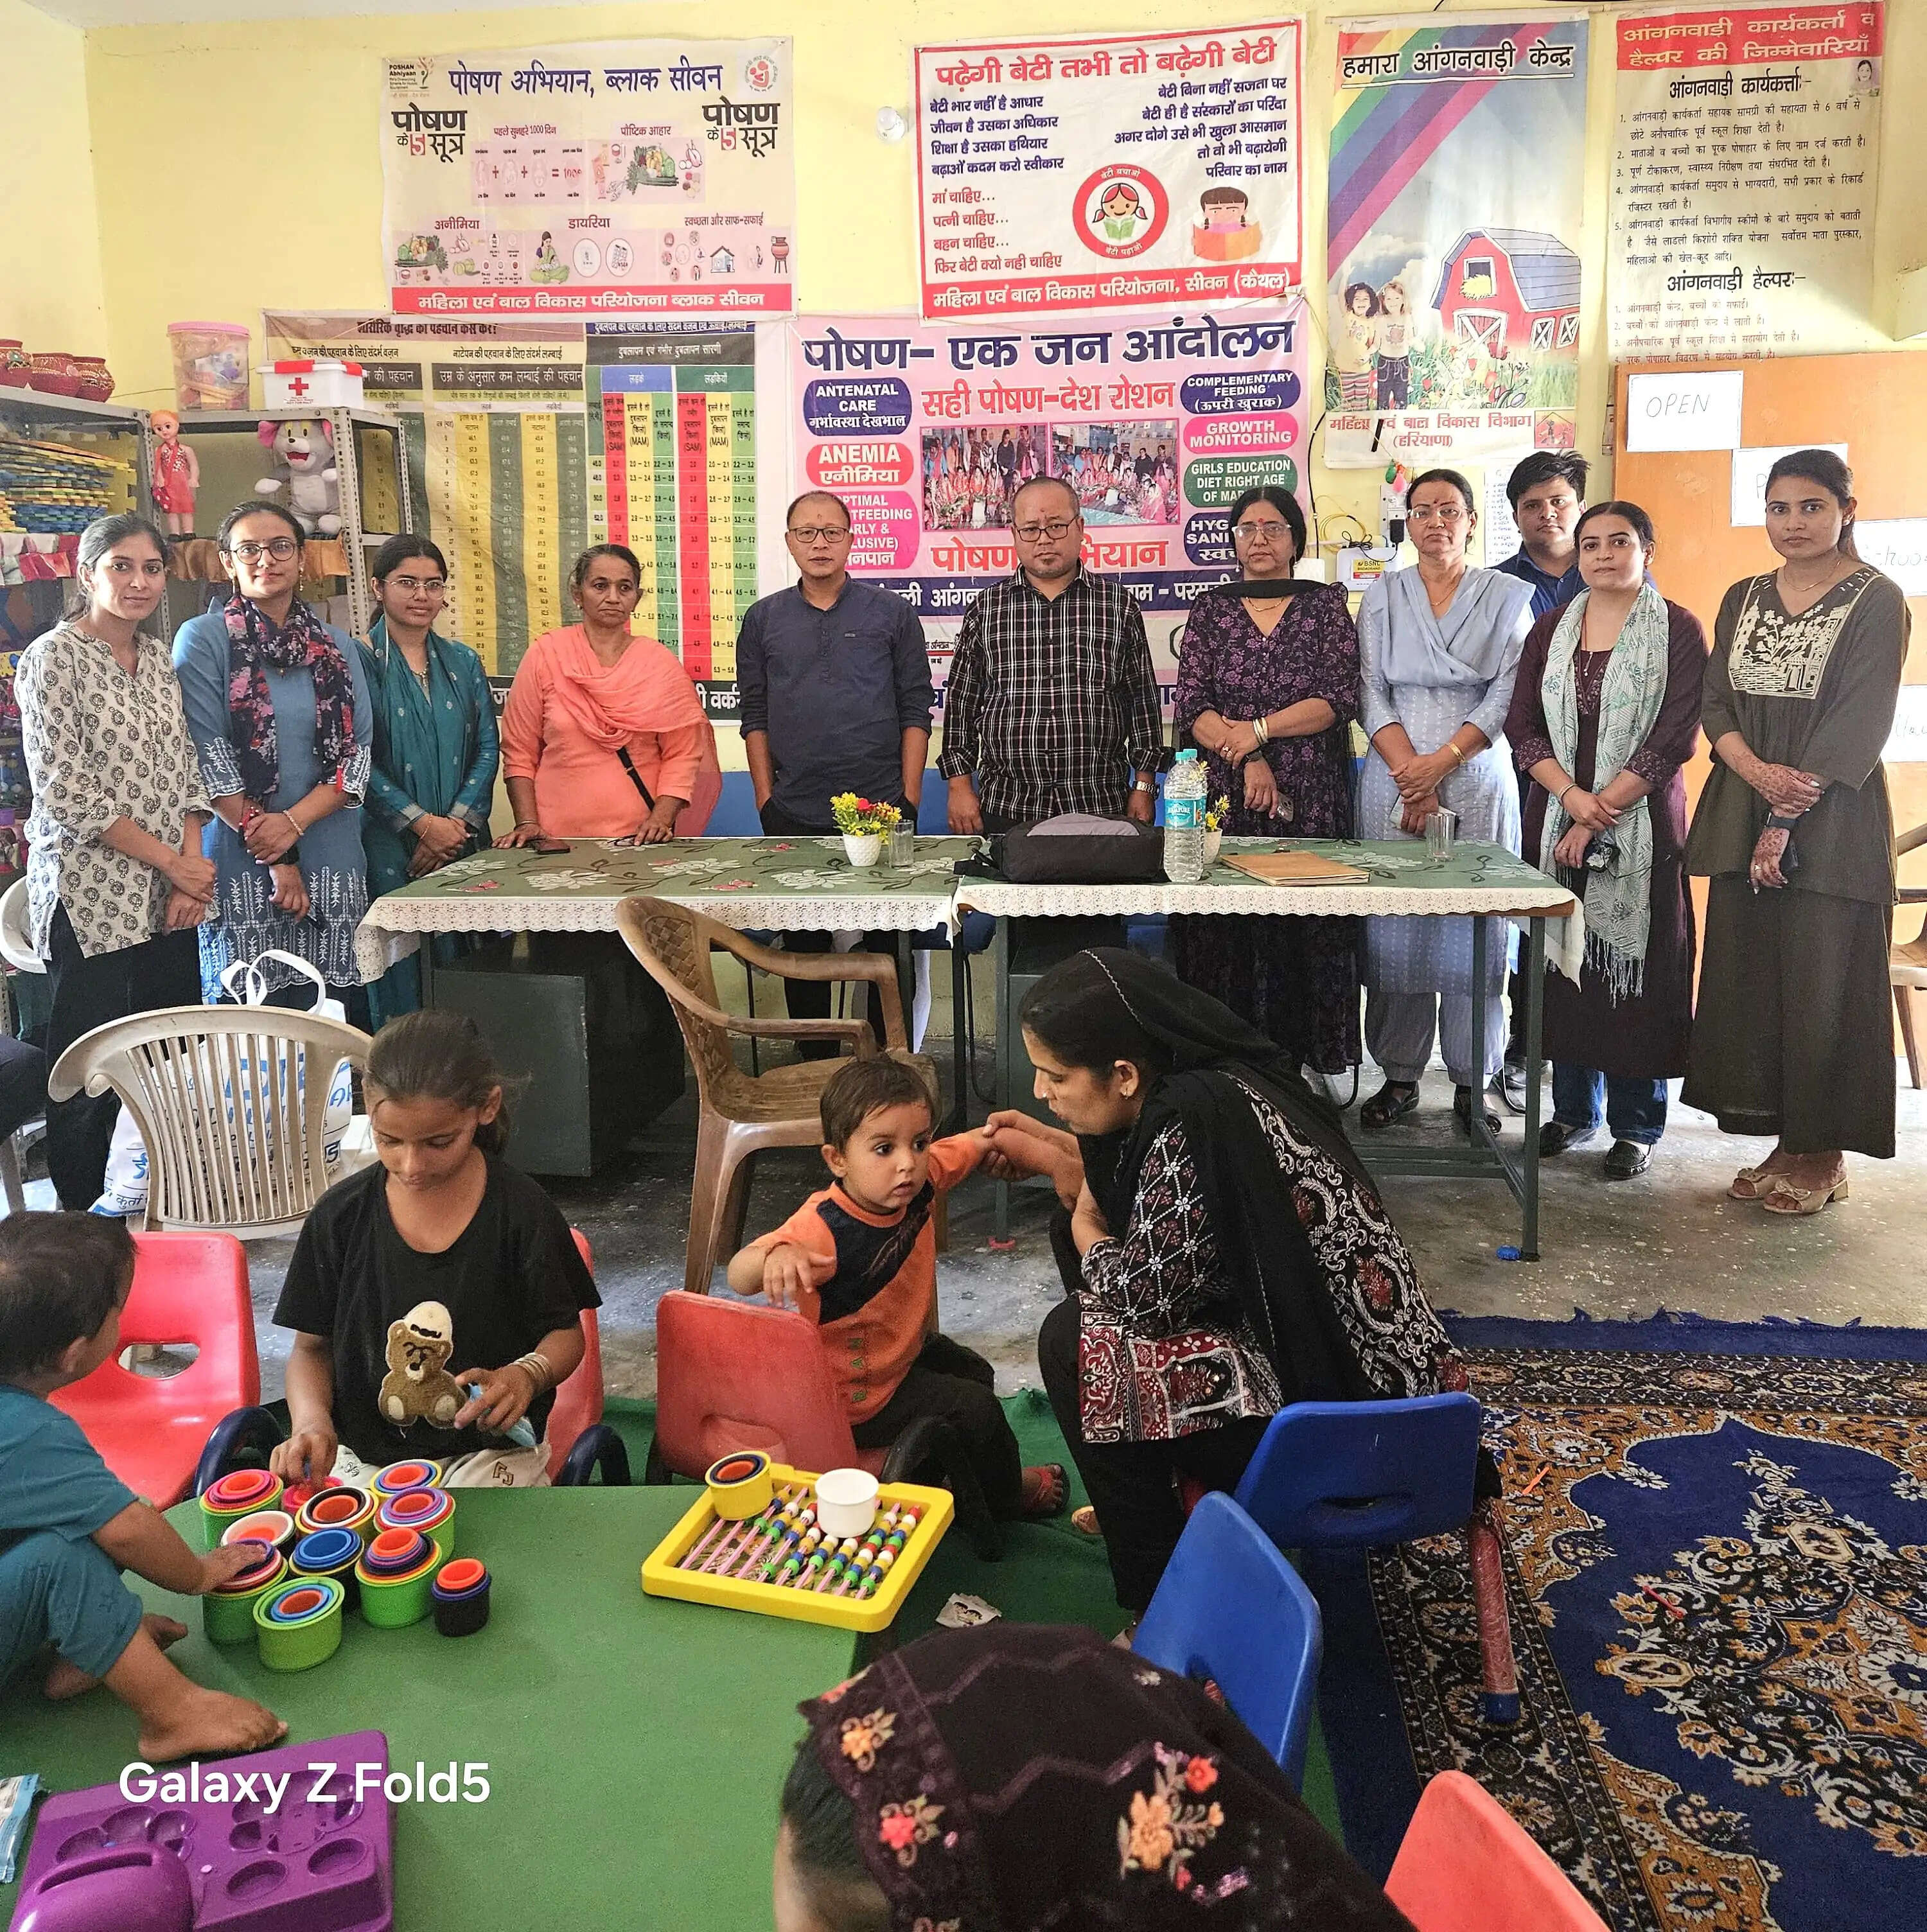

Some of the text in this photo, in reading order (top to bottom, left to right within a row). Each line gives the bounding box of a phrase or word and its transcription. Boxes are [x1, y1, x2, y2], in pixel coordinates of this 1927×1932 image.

[1624, 10, 1876, 42] आंगनवाड़ी कार्यकर्ता व
[935, 36, 1277, 92] पढ़ेगी बेटी तभी तो बढ़ेगी बेटी
[1342, 39, 1574, 78] हमारा आंगनवाड़ी केन्द्र
[1629, 48, 1682, 66] हैल्पर
[1696, 44, 1728, 62] की
[448, 60, 502, 95] पोषण
[511, 59, 594, 98] अभियान,
[604, 68, 662, 92] ब्लाक
[668, 55, 723, 91] सीवन
[1670, 71, 1733, 98] आंगनवाड़ी
[1158, 77, 1287, 98] बेटी बिना नहीं सजता घर
[930, 94, 1044, 113] बेटी भार नहीं है आधार
[1632, 110, 1667, 122] आंगनवाड़ी
[1673, 109, 1702, 120] कार्यकर्ता
[1708, 109, 1732, 118] सहायक
[1737, 105, 1759, 117] सामग्री
[1765, 104, 1775, 114] की
[1781, 103, 1806, 114] सहायता
[1813, 100, 1819, 112] से
[1825, 103, 1830, 111] 6
[1836, 99, 1847, 110] वर्ष
[1854, 98, 1860, 110] से
[391, 101, 468, 132] पोषण
[493, 124, 556, 139] पहले सुनहरे 1000 दिन
[620, 123, 672, 136] पौष्टिक आहार
[1114, 120, 1287, 143] अगर दोगे उसे भी खुला आसमान
[396, 133, 466, 162] के 5 सूत्र
[1197, 137, 1287, 159] तो वो भी बढ़ायेगी
[967, 161, 996, 173] कदम
[999, 157, 1021, 171] करो
[1024, 155, 1064, 171] स्वीकार
[1206, 162, 1287, 177] परिवार का नाम
[434, 216, 480, 229] अनीमिया
[568, 215, 610, 229] डायरिया
[685, 212, 764, 226] स्वच्छता और साफ-सफाई
[935, 258, 957, 274] फिर
[959, 257, 977, 272] बेटी
[1030, 252, 1062, 267] चाहिए
[933, 267, 1290, 308] महिला एवं बाल विकास परियोजना, सीवन (कैथल)
[1667, 266, 1743, 294] आंगनवाड़ी
[418, 289, 764, 309] महिला एवं बाल विकास परियोजना ब्लाक सीवन
[702, 342, 721, 355] सारणी
[948, 335, 1021, 371] एक
[1031, 332, 1112, 365] जन
[1122, 313, 1296, 362] आंदोलन
[439, 367, 583, 387] उम्र के अनुसार कम लम्बाई की पहचान
[1187, 373, 1293, 387] COMPLEMENTARY
[816, 384, 899, 397] ANTENATAL
[921, 378, 971, 419] सही
[1108, 373, 1175, 412] रोशन
[1215, 385, 1266, 397] FEEDING
[839, 400, 876, 412] CARE
[1194, 394, 1283, 413] (ऊपरी खुराक)
[1646, 393, 1710, 417] OPEN
[809, 413, 906, 429] गर्भावस्था देखभाल
[1206, 420, 1274, 436] GROWTH
[1330, 415, 1371, 430] महिला
[1403, 416, 1429, 429] बाल
[1437, 413, 1480, 429] विकास
[1488, 412, 1532, 428] विभाग
[629, 437, 649, 448] (MAM)
[709, 437, 728, 448] (MAM)
[1190, 431, 1292, 448] MONITORING
[1393, 432, 1452, 448] (हरियाणा)
[819, 444, 901, 464] ANEMIA
[819, 466, 900, 484] एनीमिया
[1192, 460, 1290, 475] GIRLS EDUCATION
[1197, 473, 1285, 488] DIET RIGHT AGE
[1203, 491, 1218, 502] OF
[930, 536, 1017, 572] पोषण
